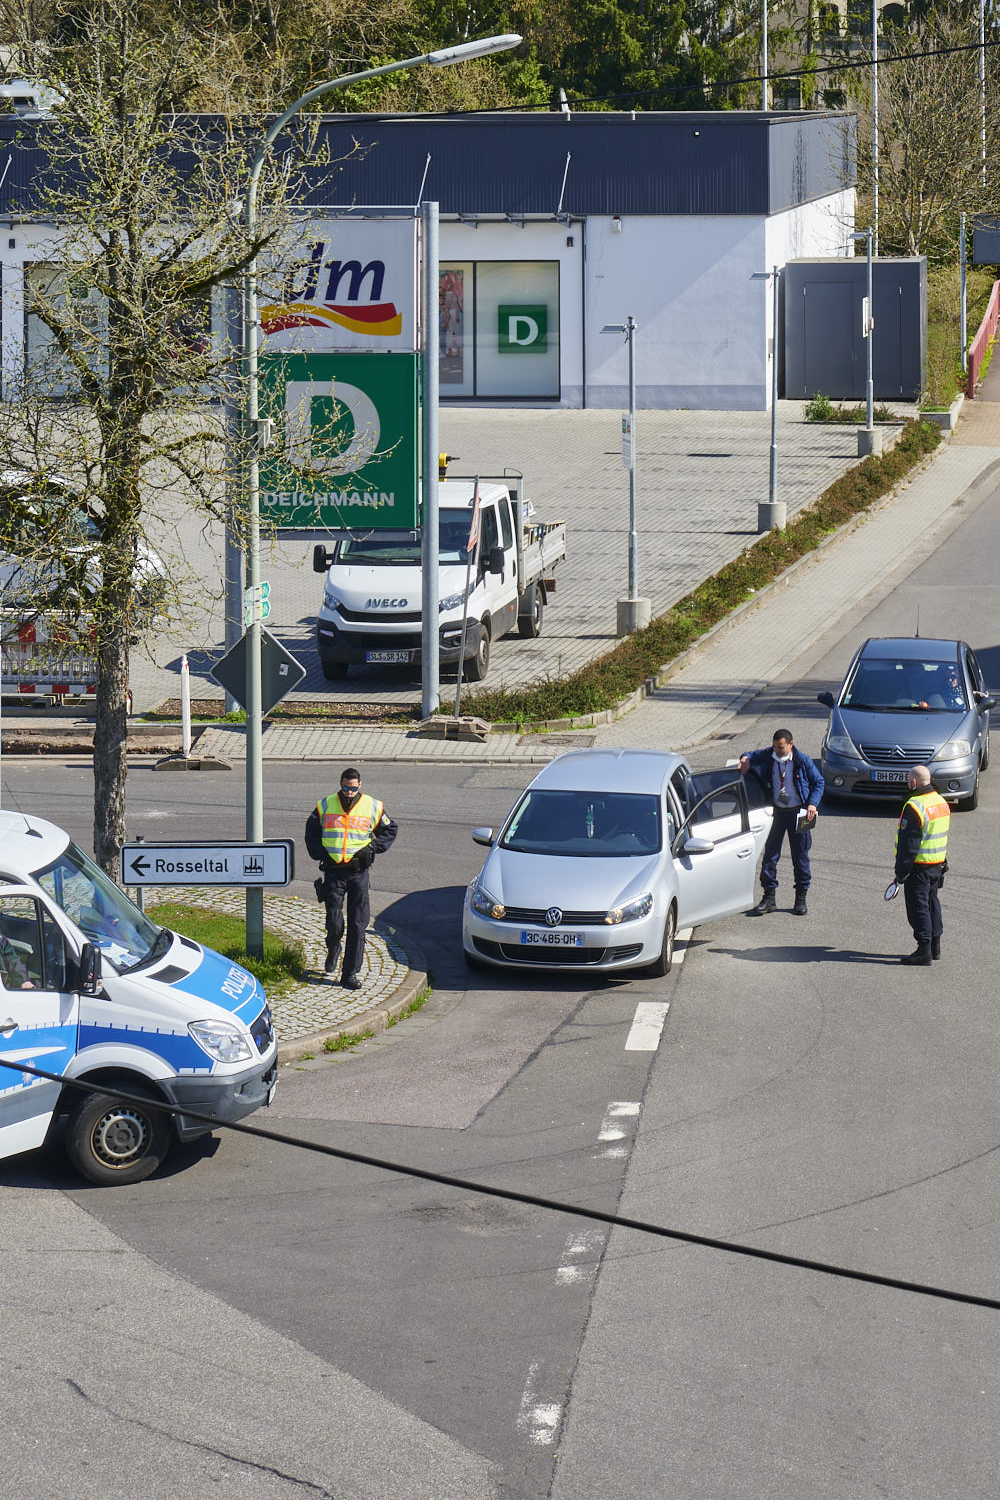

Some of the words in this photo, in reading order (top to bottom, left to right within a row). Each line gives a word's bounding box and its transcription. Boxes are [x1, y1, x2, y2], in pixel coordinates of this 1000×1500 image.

[283, 241, 386, 301] dm
[508, 315, 539, 346] D
[286, 381, 380, 477] D
[264, 491, 394, 507] DEICHMANN
[366, 598, 408, 609] IVECO
[155, 858, 229, 873] Rosseltal
